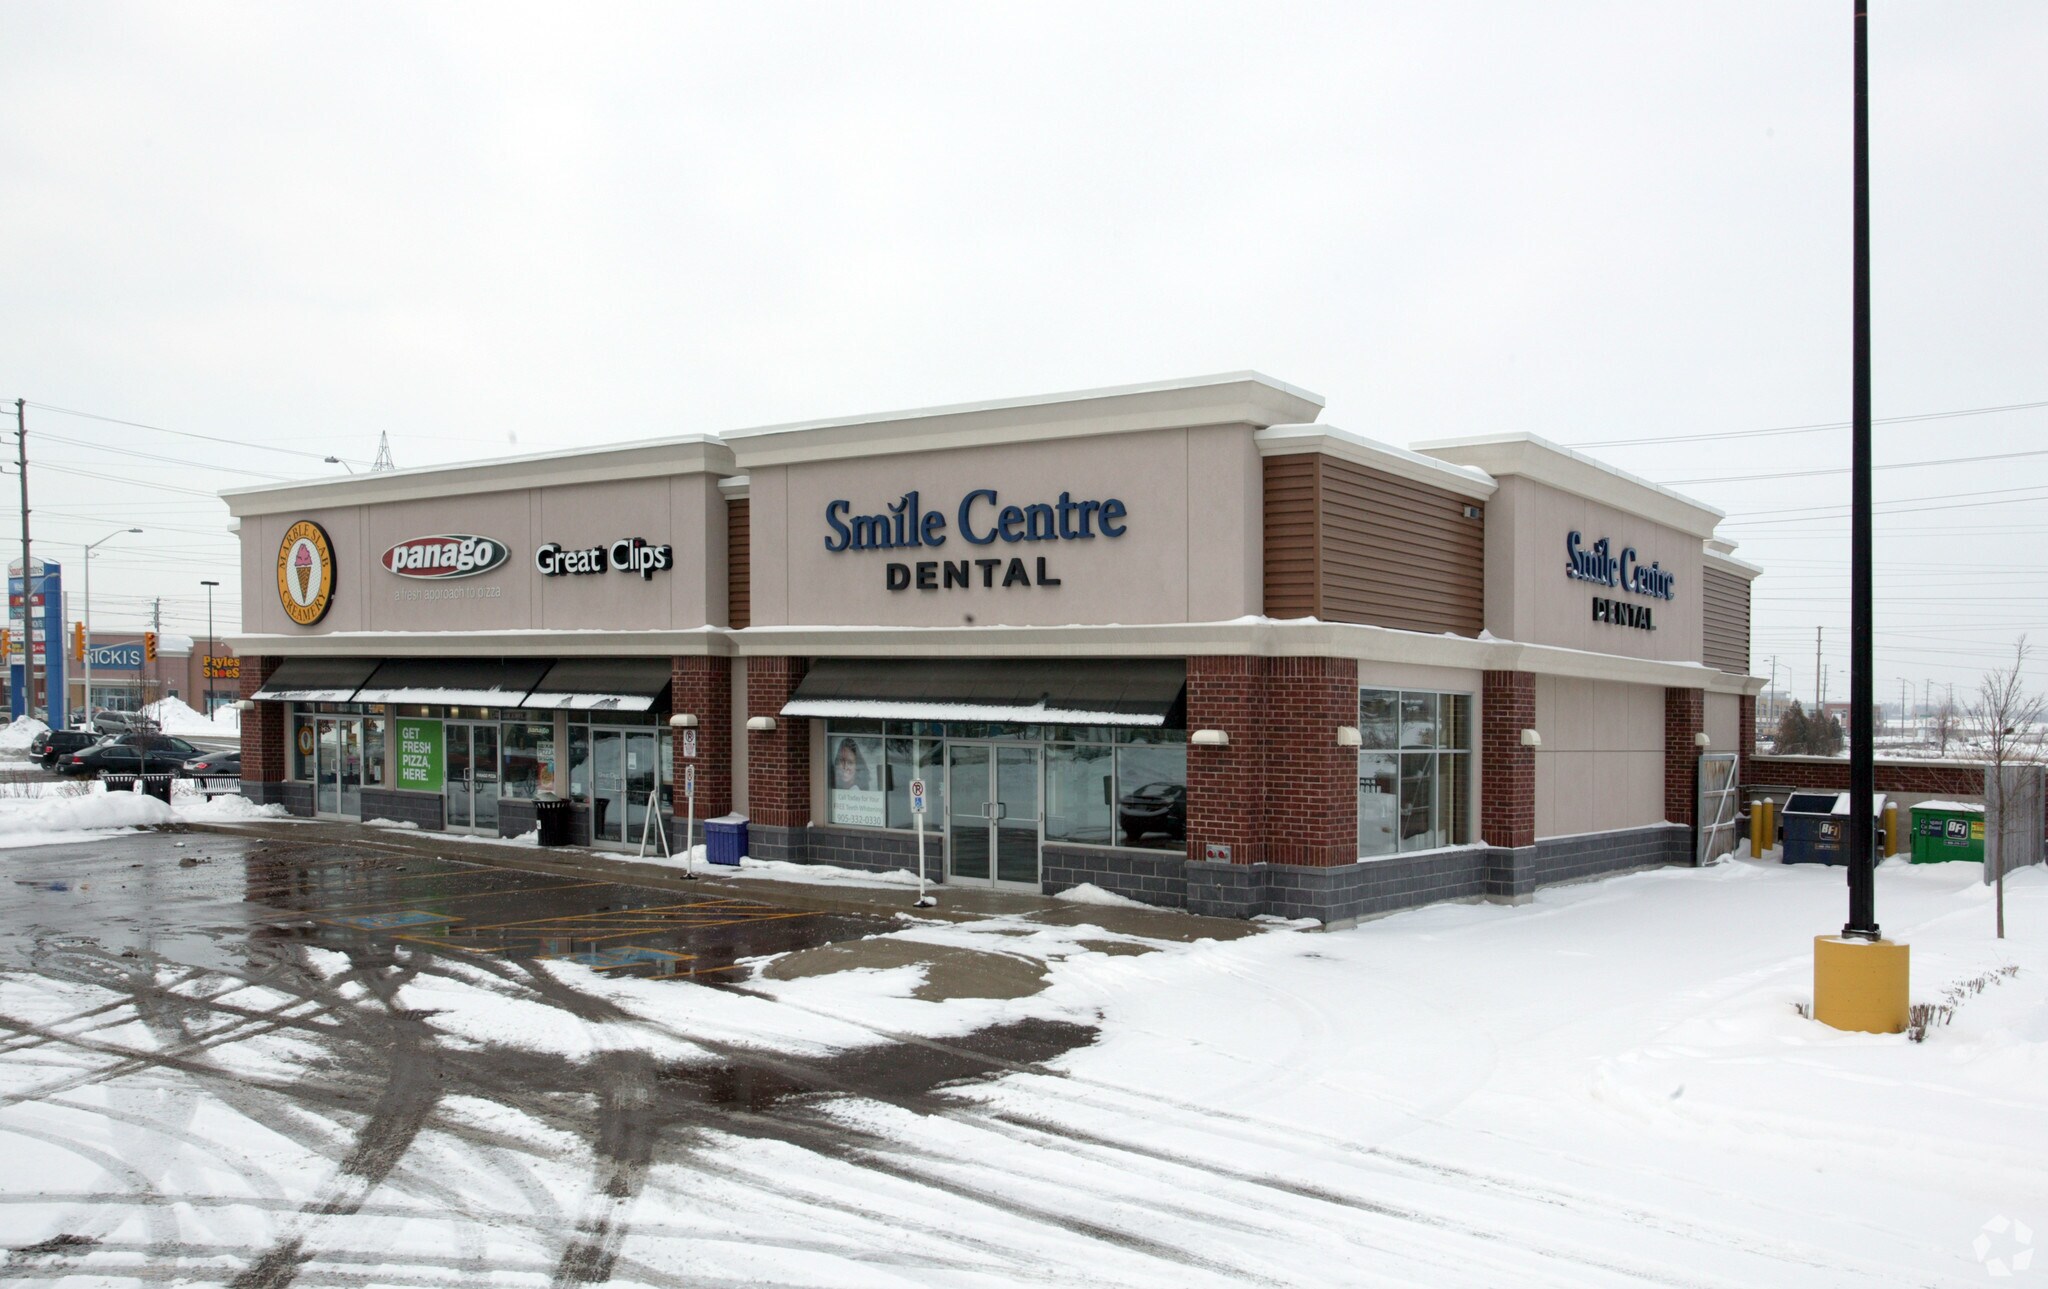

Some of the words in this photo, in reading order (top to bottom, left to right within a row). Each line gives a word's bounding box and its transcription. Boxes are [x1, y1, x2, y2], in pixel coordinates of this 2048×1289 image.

[824, 490, 947, 552] Smile
[957, 488, 1128, 545] Centre
[279, 523, 310, 570] MARBLE
[311, 528, 330, 568] SLAB
[390, 537, 494, 573] panago
[535, 544, 604, 575] Great
[609, 538, 669, 579] Clips
[886, 556, 1062, 591] DENTAL
[1565, 530, 1619, 588] Smile
[1620, 546, 1675, 601] Centre
[282, 589, 326, 622] CREAMERY
[424, 586, 464, 602] approach
[1592, 596, 1657, 630] DENTAL
[402, 727, 420, 740] GET
[402, 741, 432, 754] FRESH
[402, 768, 429, 781] HERE.
[1821, 823, 1839, 836] BFI
[1948, 821, 1966, 835] BFI
